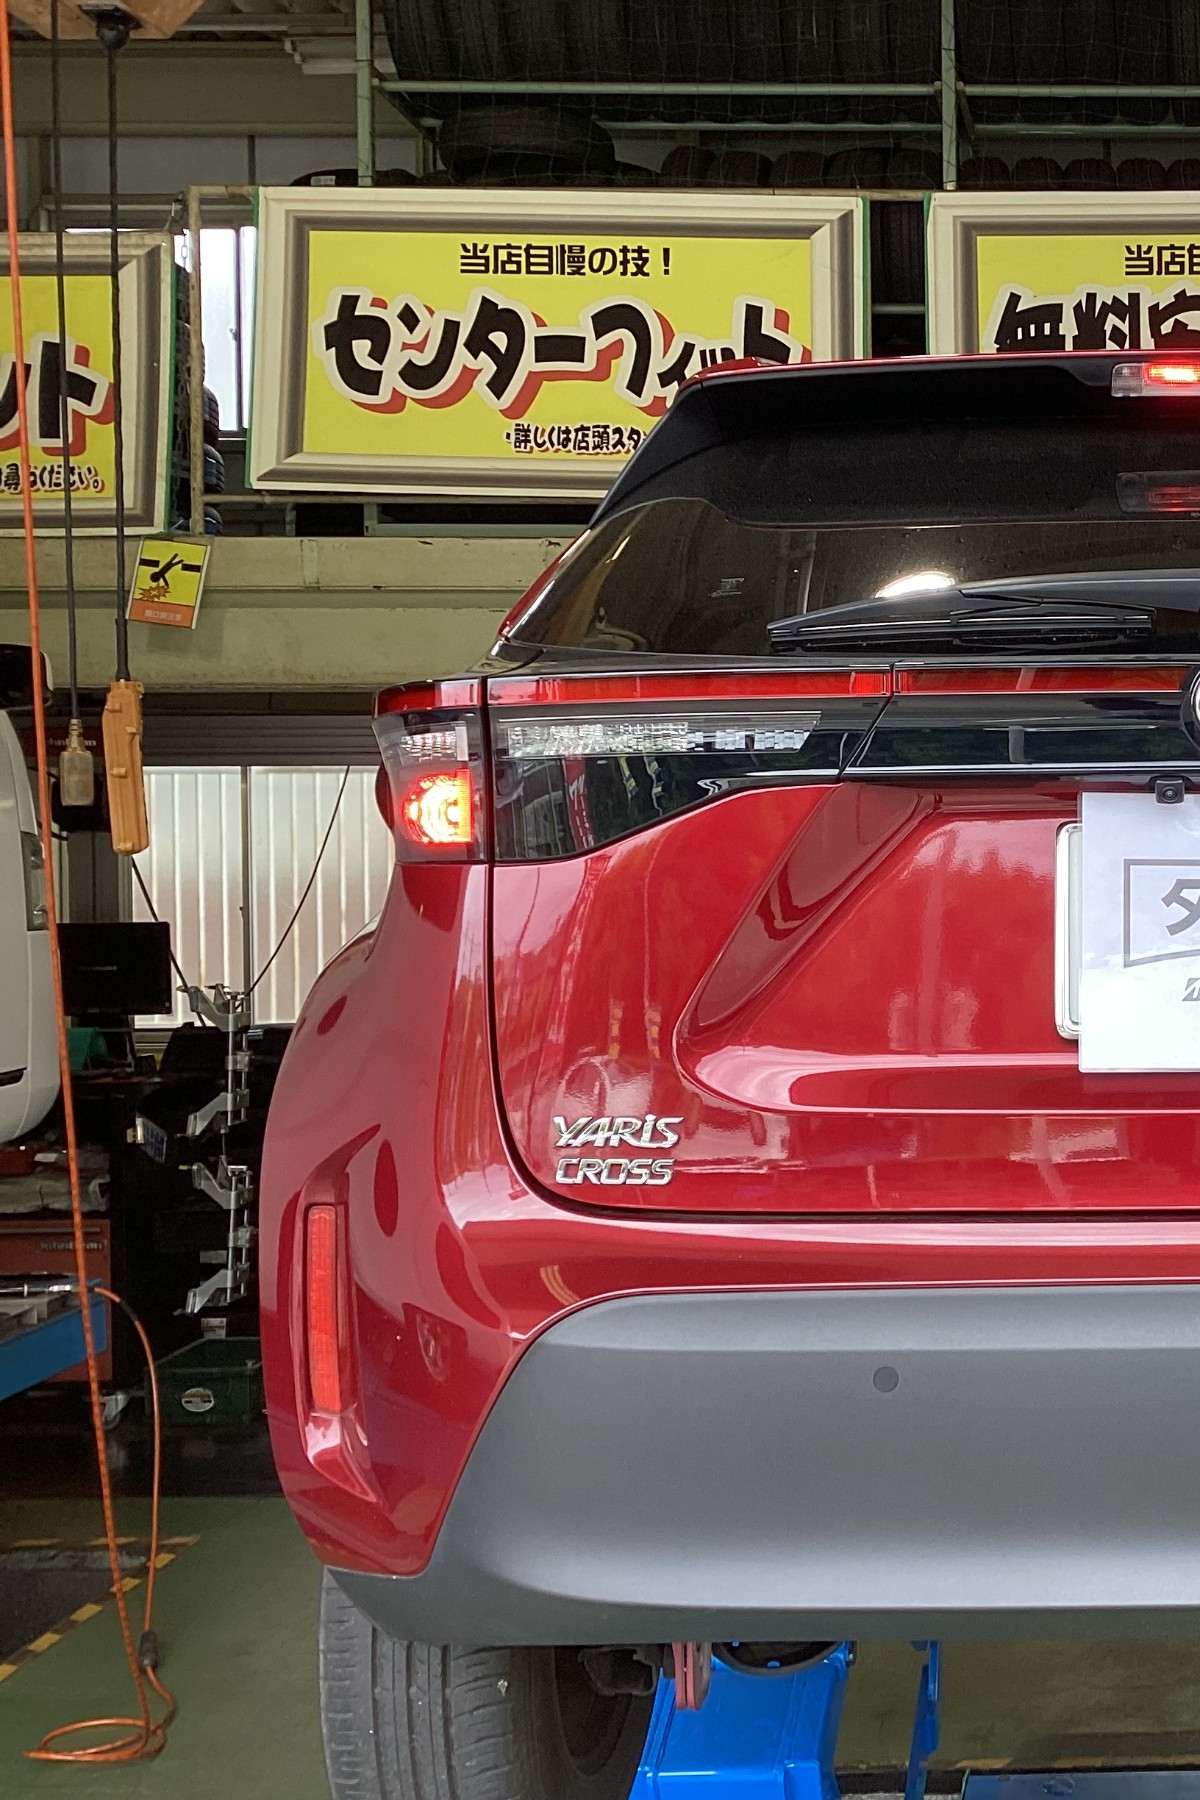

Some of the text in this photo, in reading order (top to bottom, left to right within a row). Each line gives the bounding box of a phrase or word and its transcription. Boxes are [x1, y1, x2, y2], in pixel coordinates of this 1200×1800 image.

[460, 242, 671, 277] 当店自慢の技！
[555, 1157, 676, 1185] CROSS
